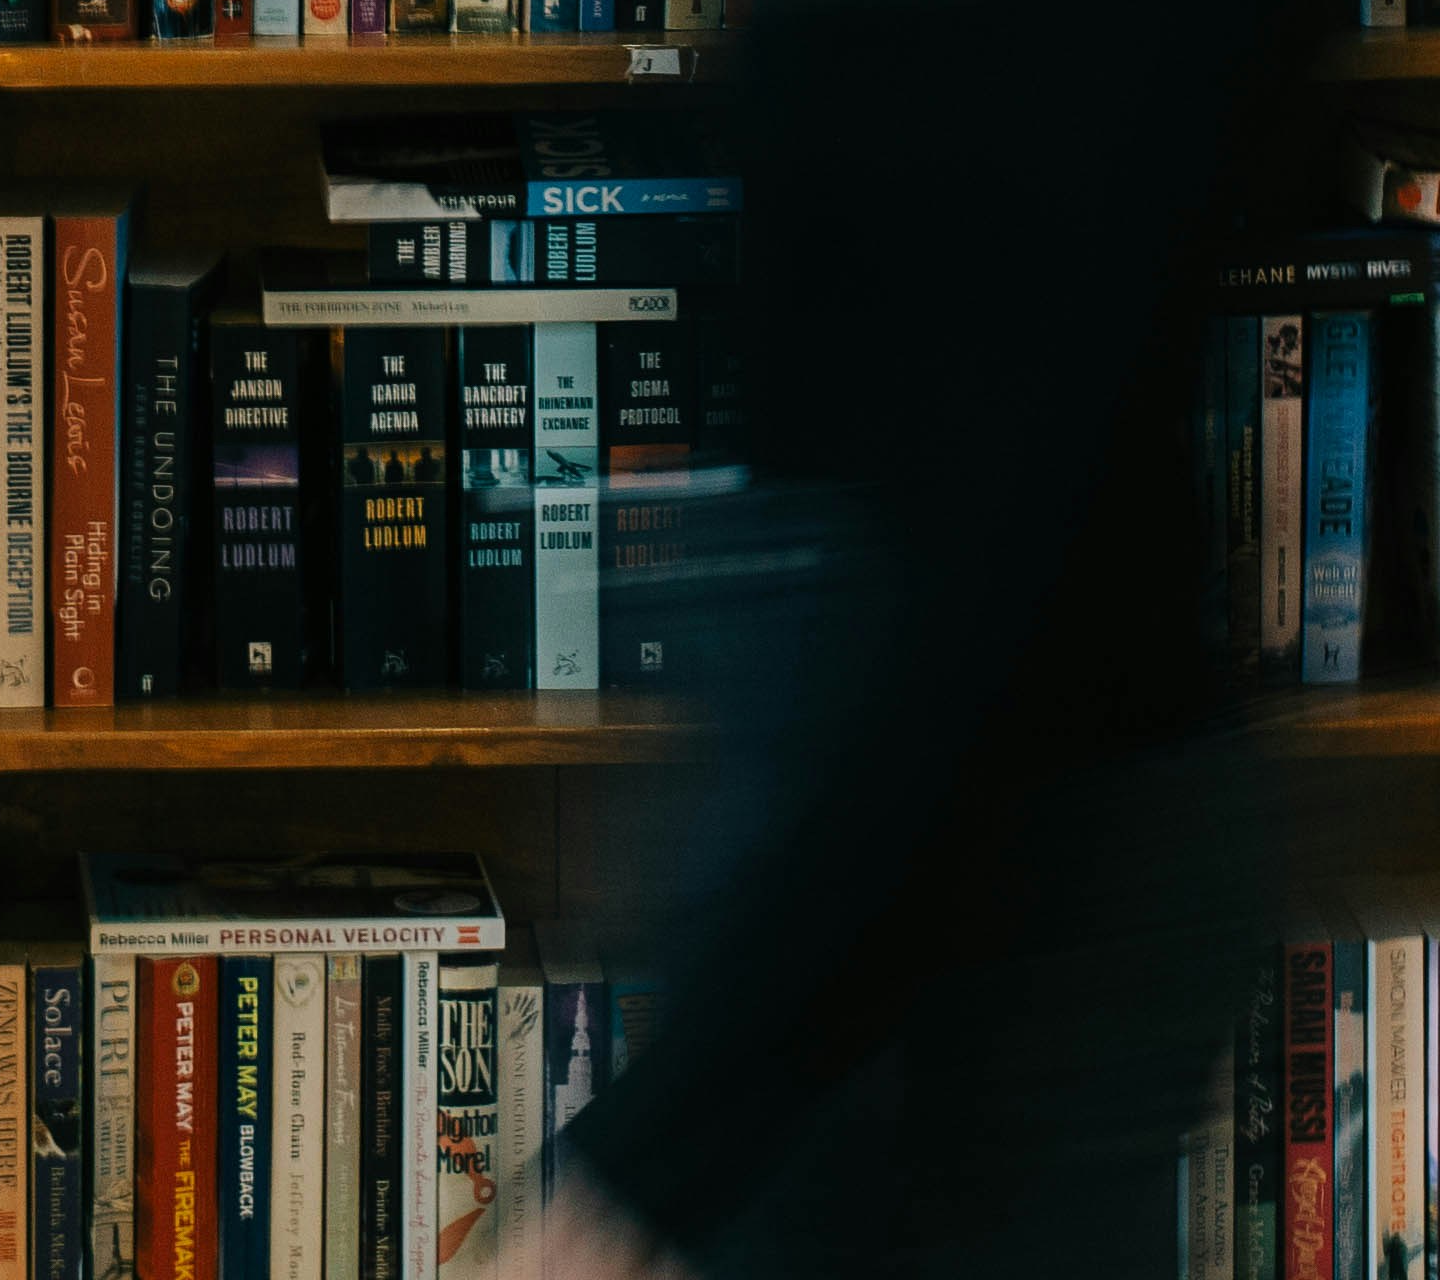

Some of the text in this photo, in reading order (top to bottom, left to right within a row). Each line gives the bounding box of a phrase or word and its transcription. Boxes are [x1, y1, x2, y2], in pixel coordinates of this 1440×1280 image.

[544, 187, 624, 212] SICK
[148, 356, 178, 602] THE UNDOING
[367, 496, 424, 520] ROBERT
[365, 525, 426, 548] LUDLUM
[220, 927, 446, 945] PERSONAL VELOCITY
[42, 988, 72, 1087] Solace
[237, 978, 259, 1215] PETER MAY BLOWBACK
